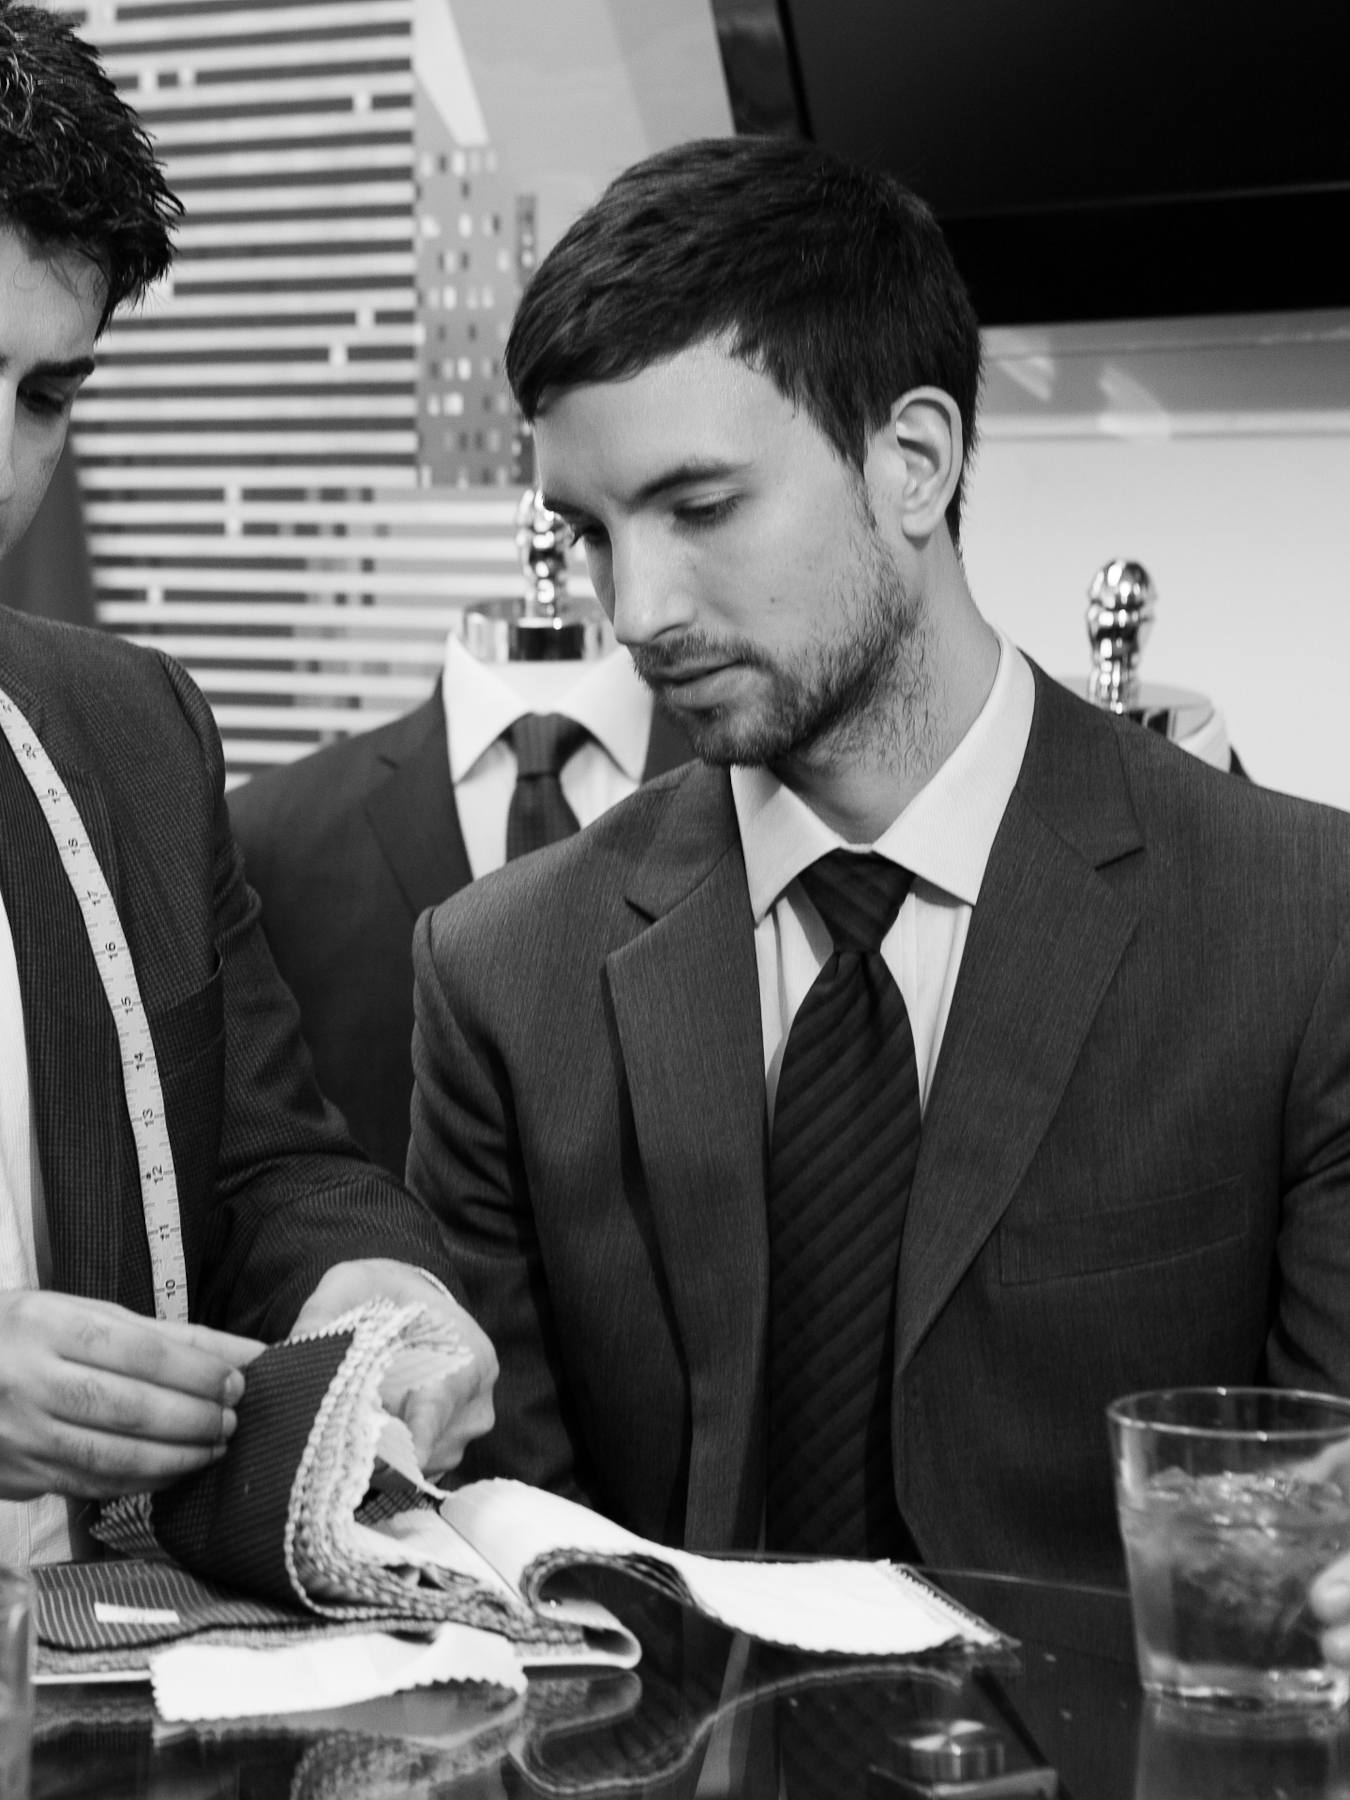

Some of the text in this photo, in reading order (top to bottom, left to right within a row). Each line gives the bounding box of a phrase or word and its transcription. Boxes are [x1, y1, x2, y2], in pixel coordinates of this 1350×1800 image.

[47, 788, 61, 804] 19
[68, 837, 80, 857] 18
[87, 890, 101, 907] 17
[105, 941, 118, 961] 16
[121, 996, 133, 1016] 15
[134, 1051, 145, 1072] 14
[142, 1108, 155, 1128] 13
[152, 1164, 164, 1186] 12
[159, 1223, 170, 1241] 11
[165, 1279, 176, 1300] 10
